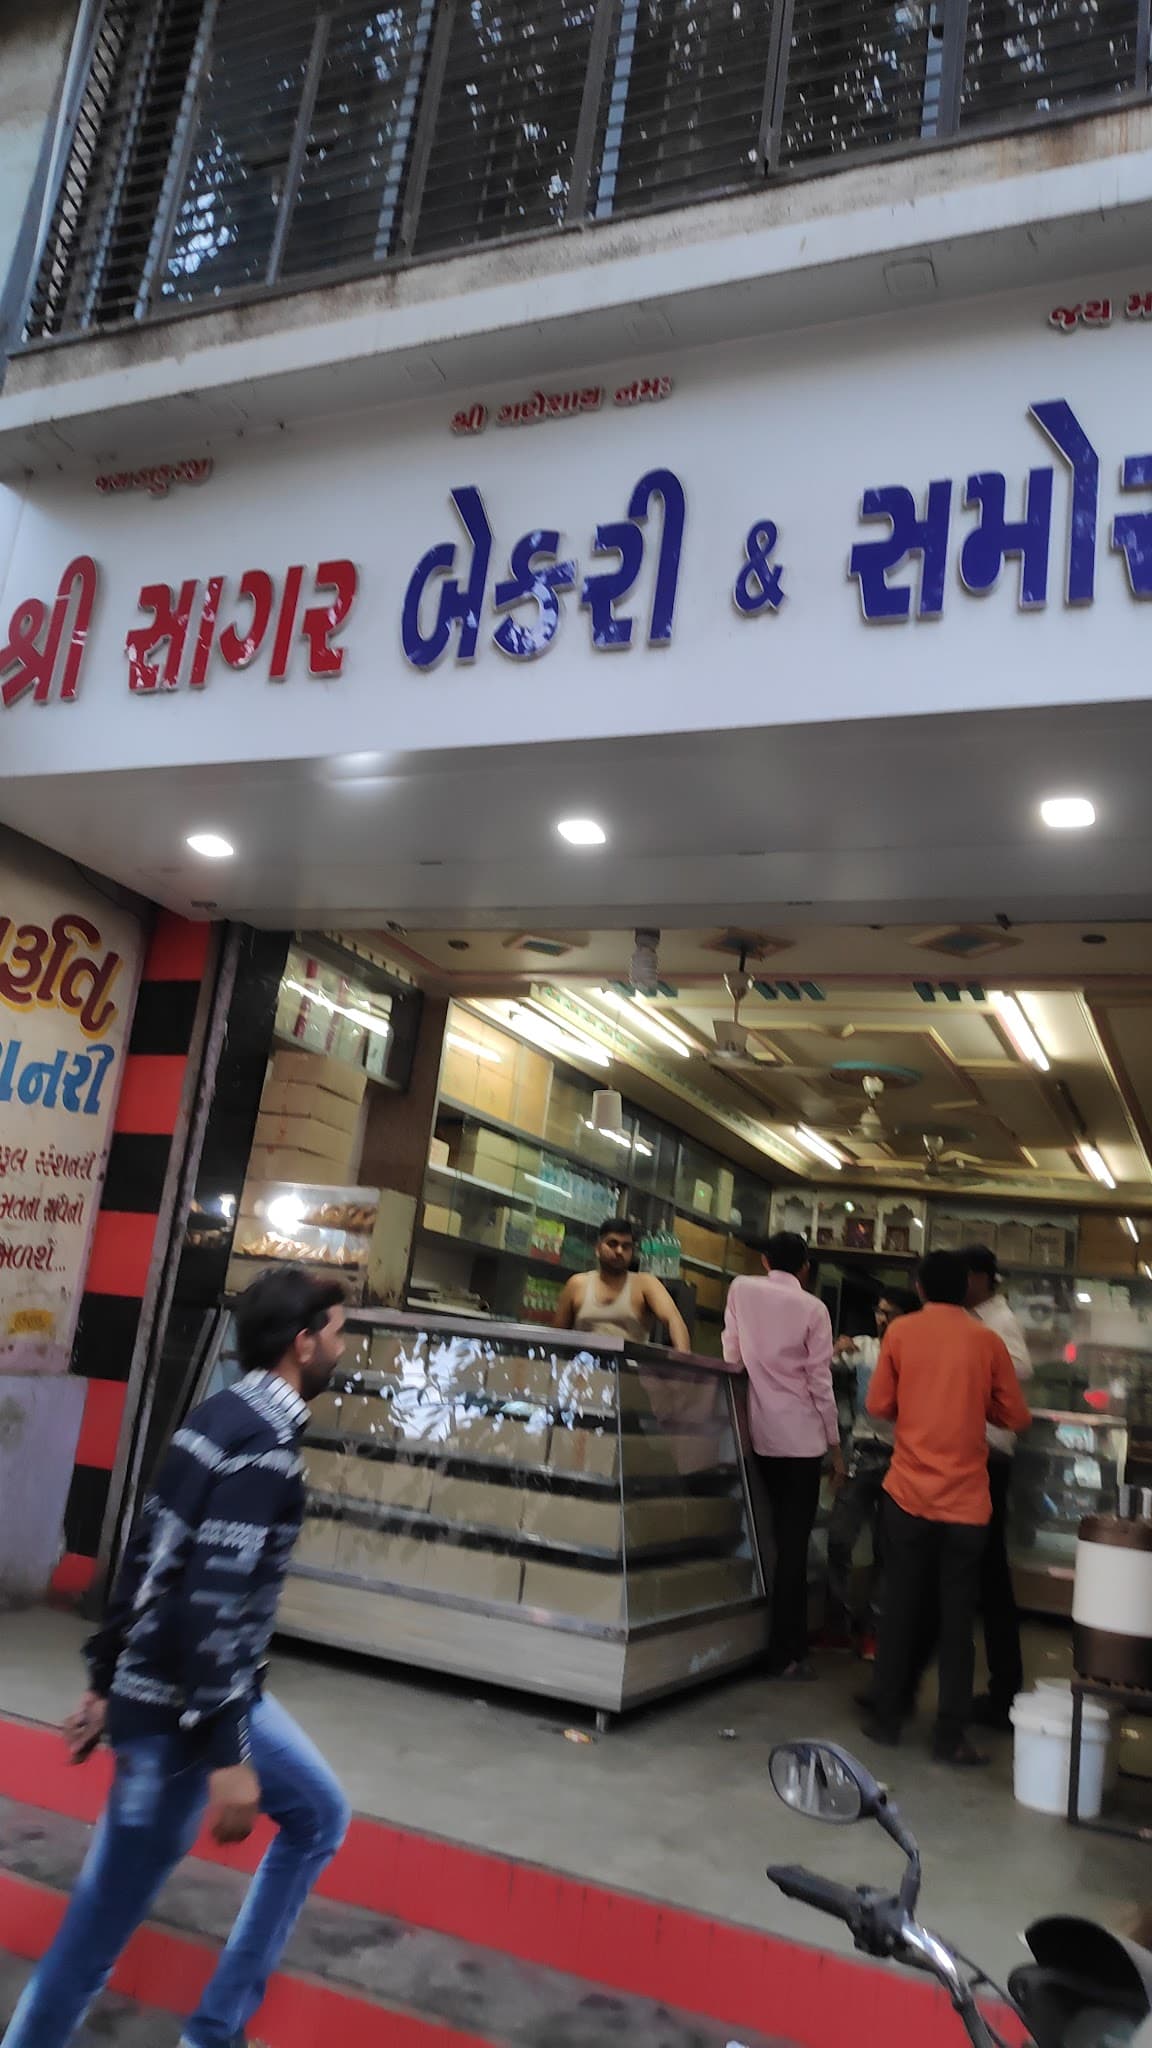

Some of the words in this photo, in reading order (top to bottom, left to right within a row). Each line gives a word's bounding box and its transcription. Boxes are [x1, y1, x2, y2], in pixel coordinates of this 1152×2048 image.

[0, 555, 99, 706] શ્રી
[125, 559, 359, 694] સાગર
[401, 468, 687, 672] બેકરી
[733, 519, 787, 617] &
